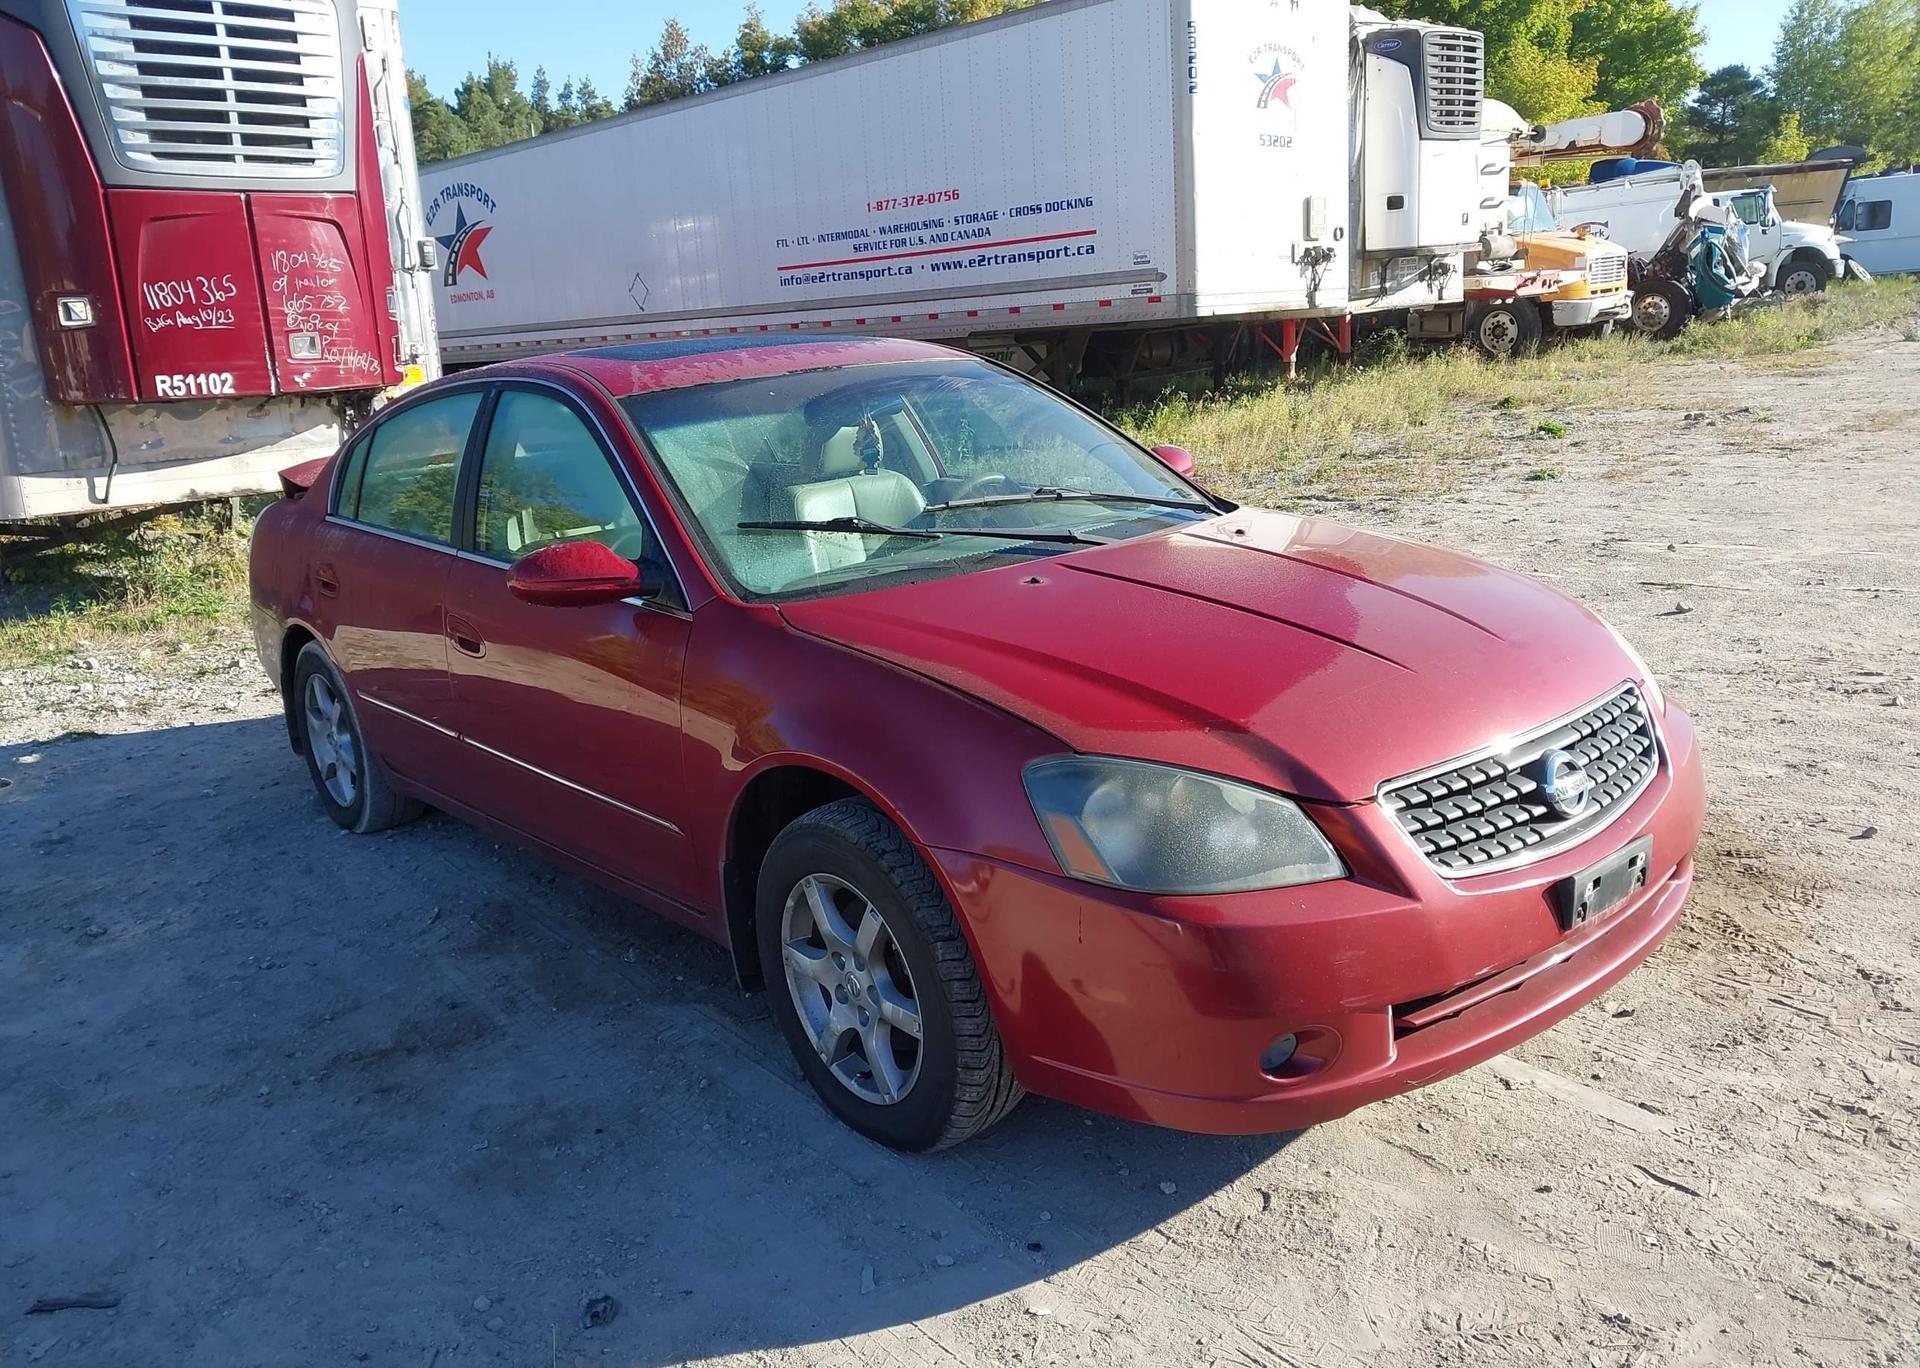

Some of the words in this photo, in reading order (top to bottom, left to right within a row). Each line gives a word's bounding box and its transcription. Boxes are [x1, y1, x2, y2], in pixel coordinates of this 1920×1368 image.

[1264, 43, 1306, 71] TRANSPORT
[1259, 134, 1293, 148] 53202
[426, 198, 441, 227] E2R
[440, 182, 497, 214] TRANSPORT
[866, 189, 960, 213] 1-877-372-0756
[776, 239, 790, 249] FTL
[797, 235, 810, 246] LTL
[817, 228, 870, 244] INTERMODAL
[879, 218, 945, 236] WAREHOUSING
[953, 210, 999, 226] STORAGE
[1009, 203, 1043, 218] CROSS
[1045, 196, 1094, 213] DOCKING
[852, 240, 888, 254] SERVICE
[889, 238, 908, 249] FOR
[909, 235, 928, 247] U.S.
[929, 232, 949, 244] AND
[950, 227, 992, 241] CANADA
[779, 265, 914, 288] info@e2rtransport.ca
[930, 244, 1096, 273] www.e2rtransport.ca
[450, 291, 486, 304] EDMONTON,
[154, 372, 236, 397] R51102
